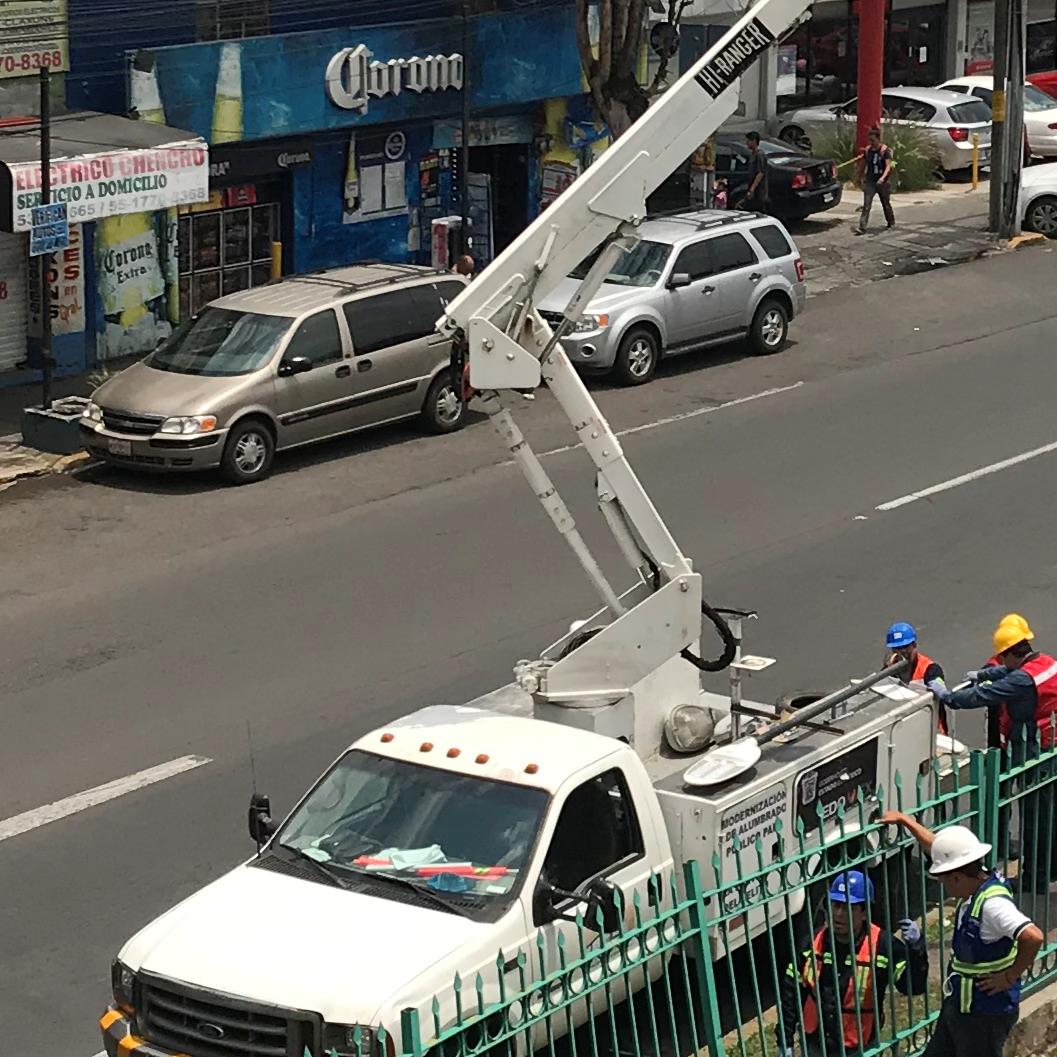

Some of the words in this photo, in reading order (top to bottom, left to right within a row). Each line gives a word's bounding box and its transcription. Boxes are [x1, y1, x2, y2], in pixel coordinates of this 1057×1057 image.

[699, 21, 771, 94] HI-RANGER
[325, 44, 463, 115] Corona
[119, 147, 205, 177] CHENCHO
[17, 185, 82, 210] SERICIO
[85, 183, 94, 200] A
[98, 174, 167, 197] DOMICILIO
[116, 266, 147, 285] Extra
[720, 790, 787, 831] MODERNIZACIÓN
[738, 803, 787, 835] ALUMBRADO
